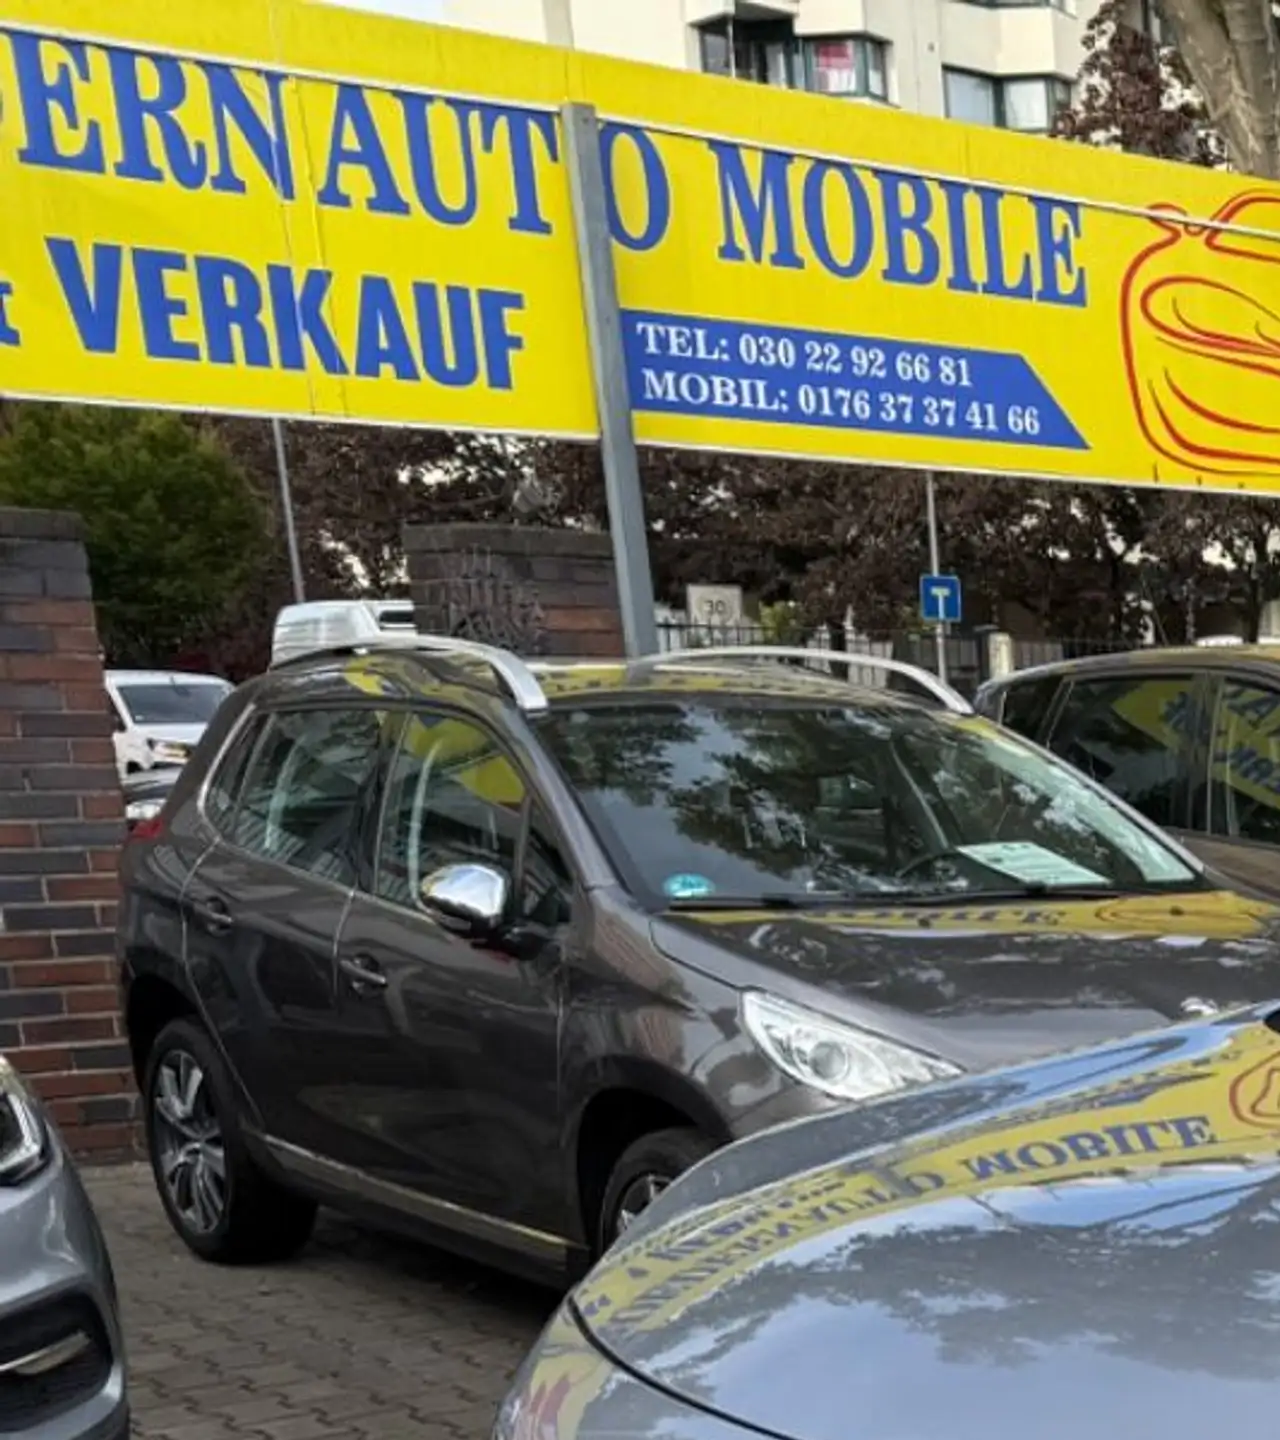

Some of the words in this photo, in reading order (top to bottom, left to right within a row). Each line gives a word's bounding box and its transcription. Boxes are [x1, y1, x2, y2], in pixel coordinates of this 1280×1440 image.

[706, 138, 1088, 307] MOBILE
[44, 235, 524, 391] VERKAUF
[635, 321, 731, 362] TEL:
[738, 333, 797, 369] 030
[804, 340, 843, 374] 22
[850, 345, 888, 379] 92
[895, 351, 931, 384] 66
[938, 355, 973, 387] 81
[641, 366, 790, 414] MOBIL:
[797, 384, 872, 420] 0176
[878, 391, 914, 424] 37
[922, 396, 956, 428] 37
[964, 401, 999, 432] 41
[1007, 405, 1041, 435] 66
